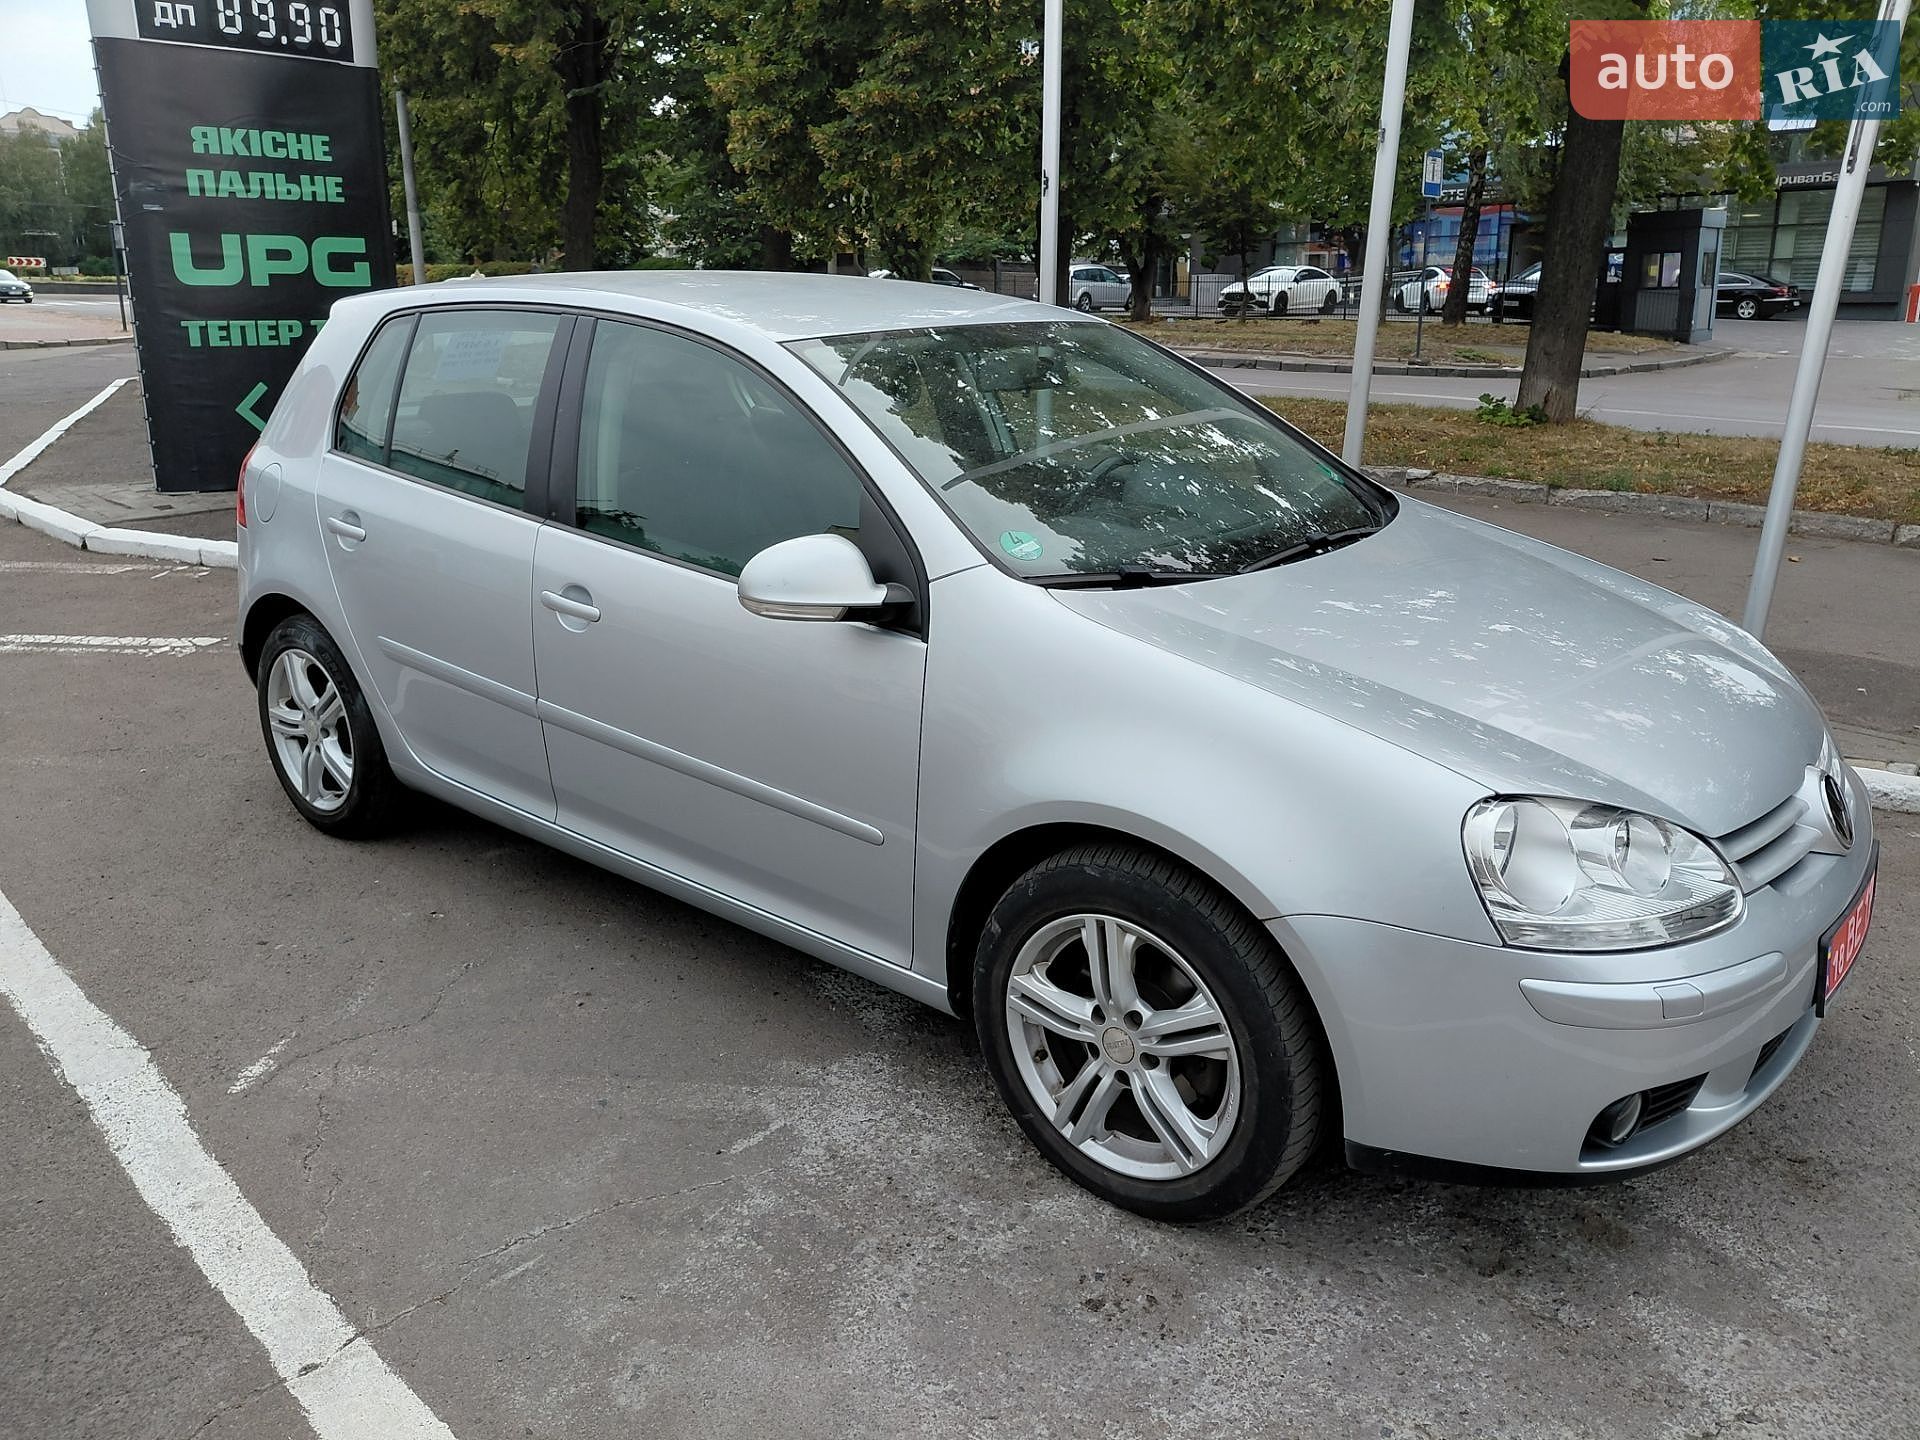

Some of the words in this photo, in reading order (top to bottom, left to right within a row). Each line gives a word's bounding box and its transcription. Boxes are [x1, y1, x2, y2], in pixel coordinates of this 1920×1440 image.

[154, 1, 196, 29] ДП
[190, 126, 333, 162] ЯКІСНЕ
[186, 168, 345, 203] ПАЛЬНЕ
[1775, 171, 1840, 187] риватБа
[169, 232, 372, 287] UPG
[181, 320, 303, 347] ТЕПЕР
